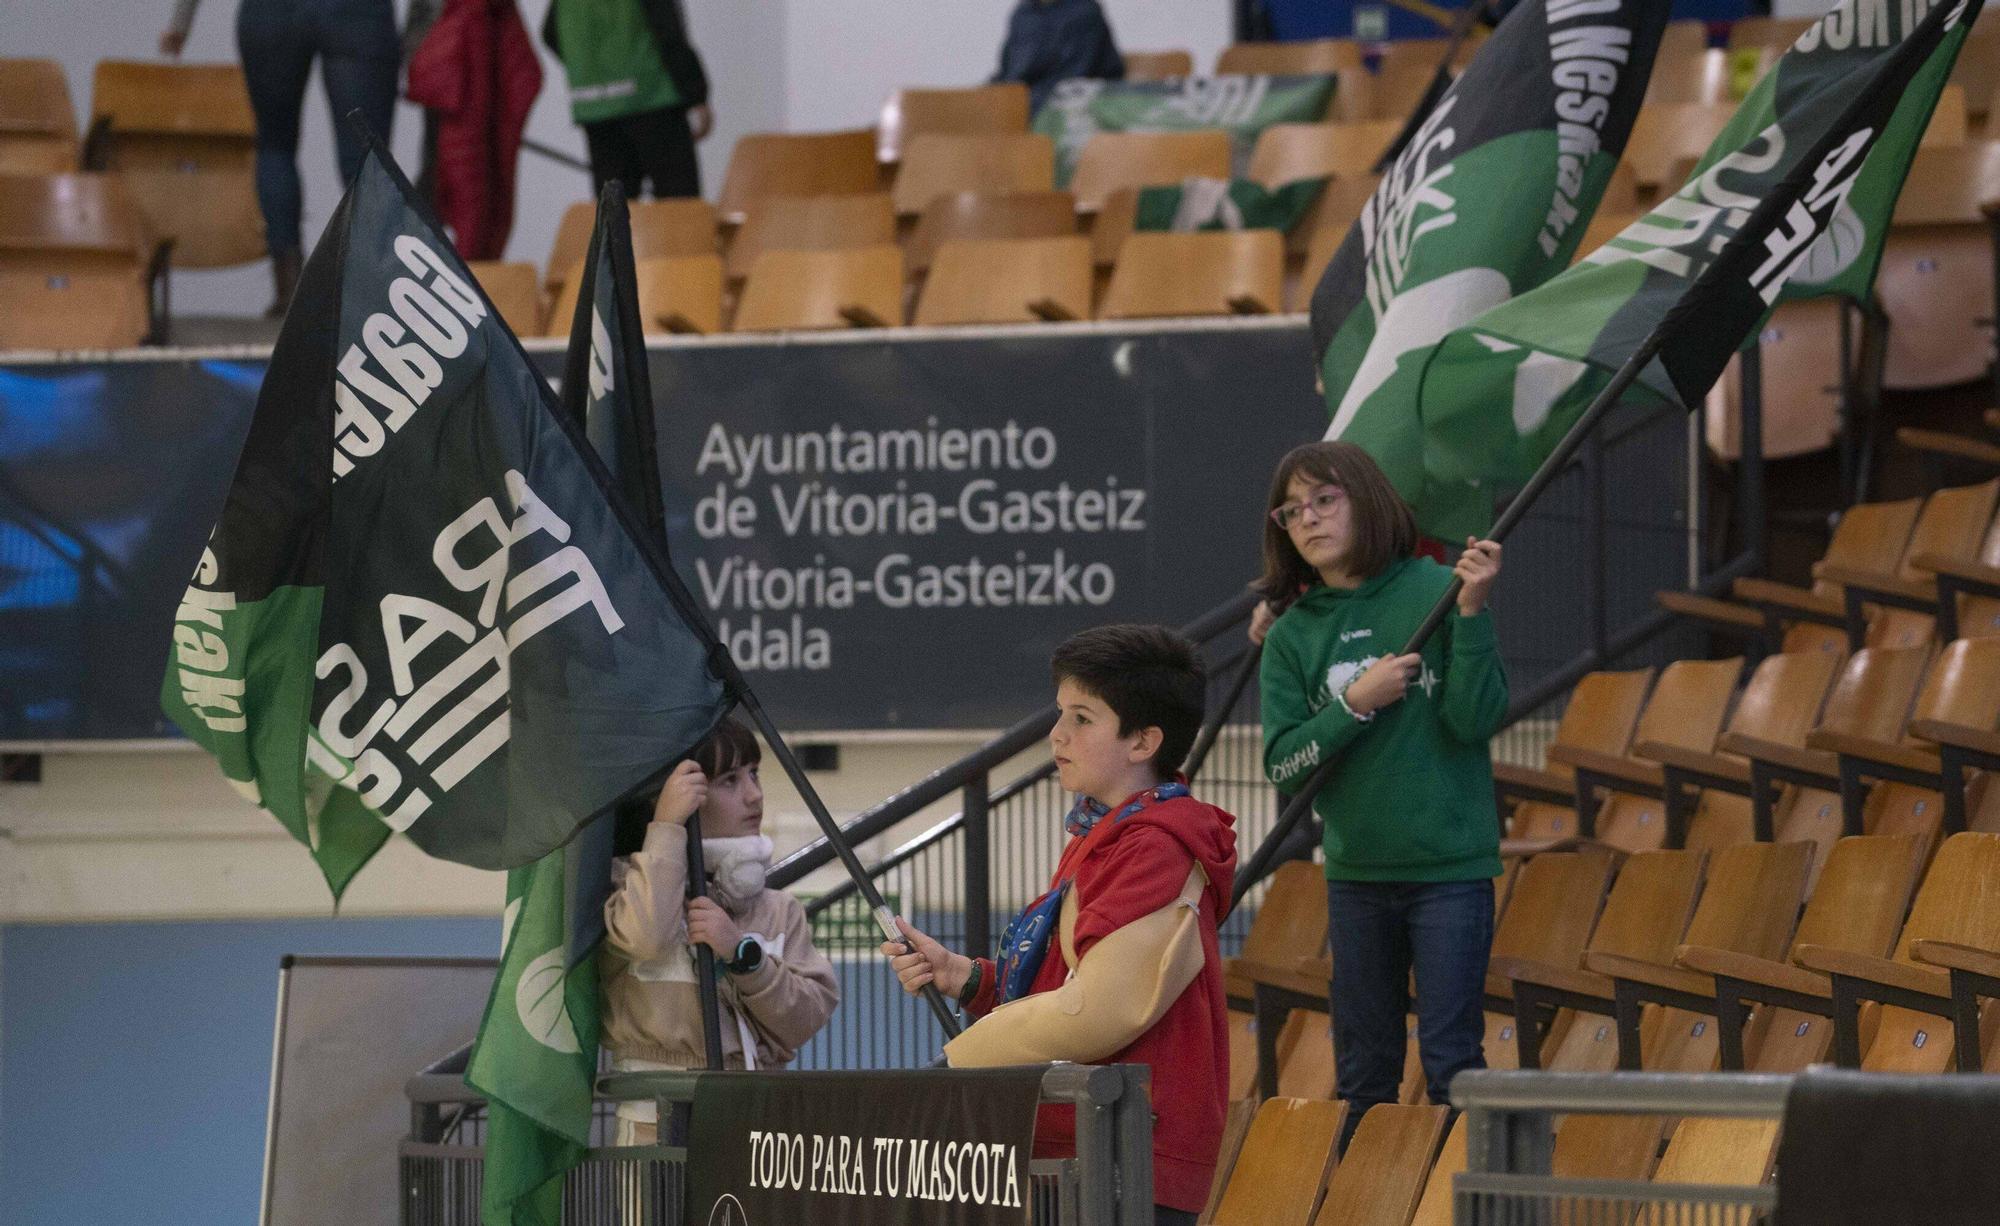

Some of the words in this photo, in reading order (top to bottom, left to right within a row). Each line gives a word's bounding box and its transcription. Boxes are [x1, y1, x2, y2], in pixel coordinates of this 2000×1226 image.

[696, 415, 1057, 488] Ayuntamiento
[695, 482, 757, 538] de
[771, 475, 1147, 537] Vitoria-Gasteiz
[696, 547, 1116, 611] Vitoria-Gasteizko
[750, 1131, 804, 1190] TODO
[810, 1134, 866, 1195] PARA
[873, 1137, 903, 1198] TU
[906, 1139, 1021, 1207] MASCOTA
